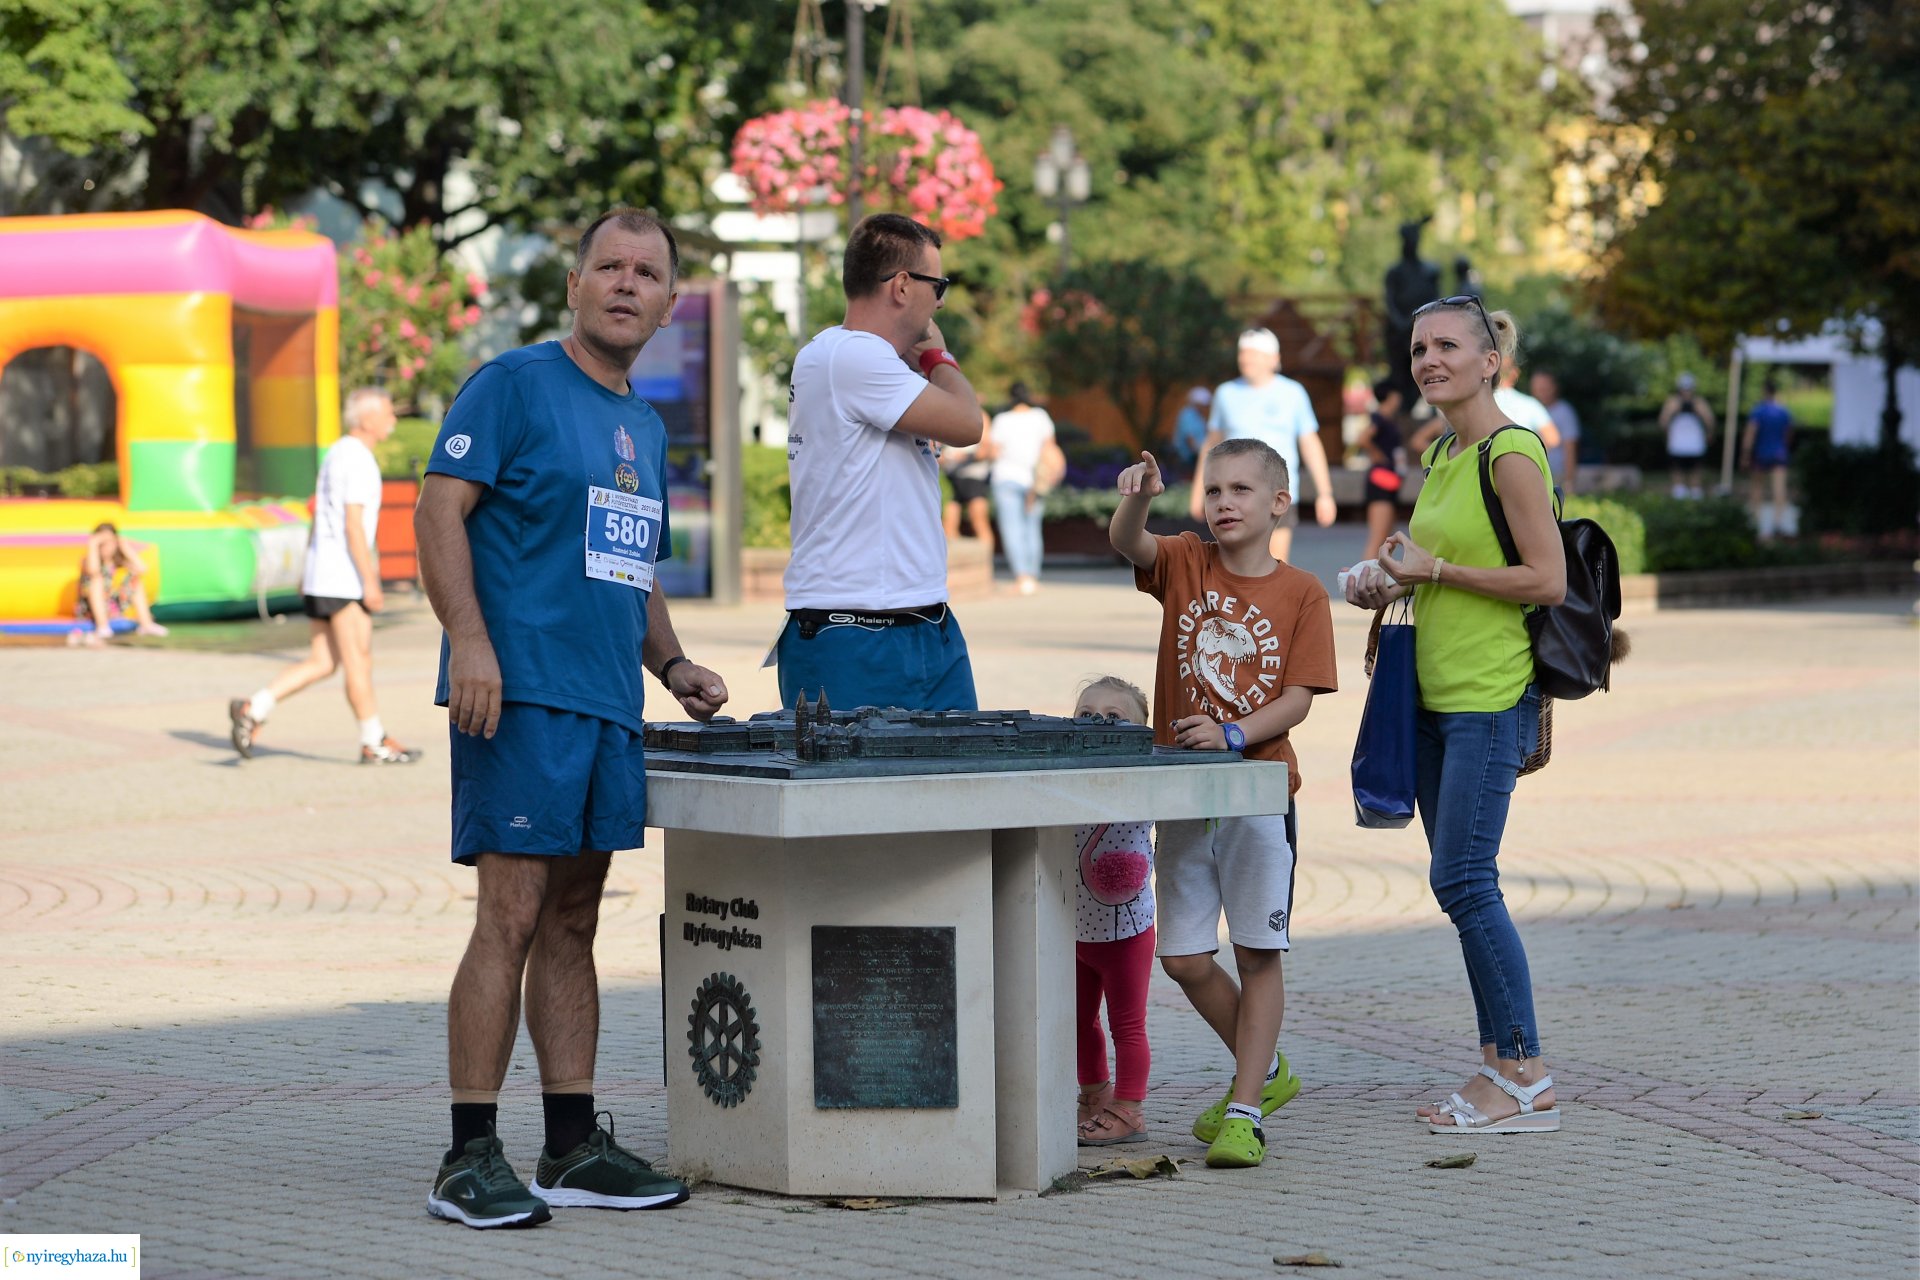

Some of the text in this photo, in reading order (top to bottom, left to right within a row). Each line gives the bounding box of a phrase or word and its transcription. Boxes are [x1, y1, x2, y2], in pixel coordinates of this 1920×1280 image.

[604, 512, 650, 549] 580
[857, 616, 895, 626] Kalenji
[1234, 604, 1281, 715] FOREVER
[685, 892, 759, 921] Rotary Club
[682, 922, 762, 951] Nyíregyháza
